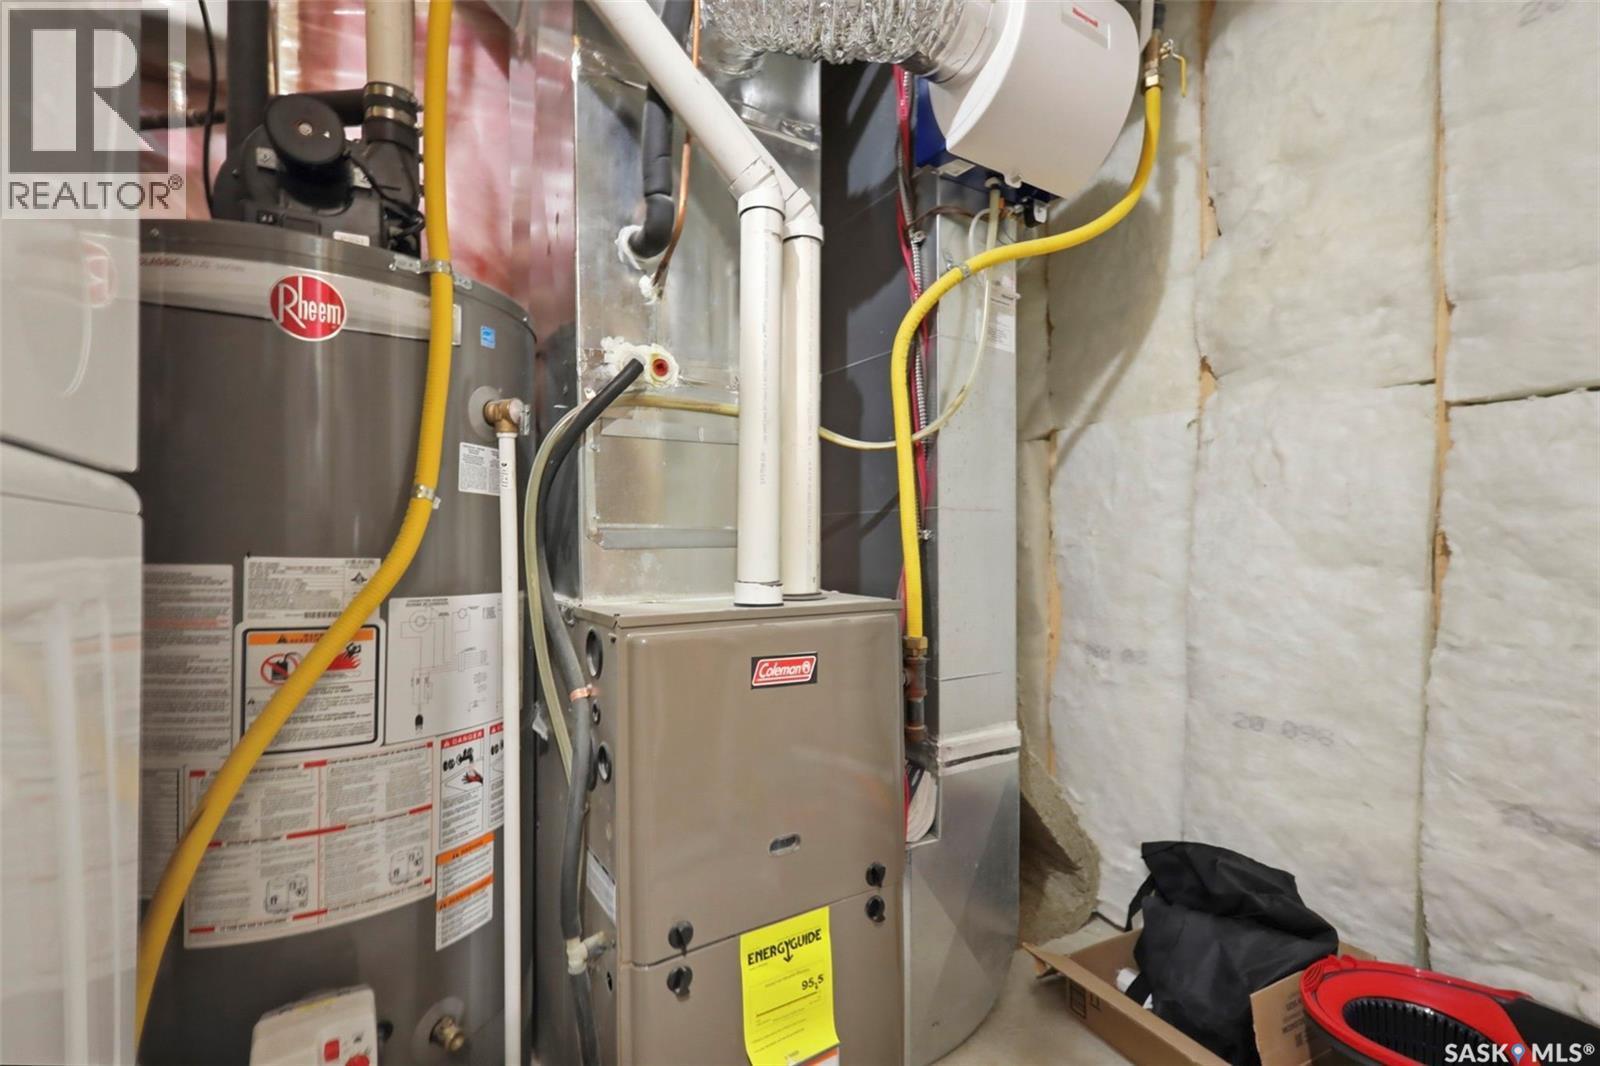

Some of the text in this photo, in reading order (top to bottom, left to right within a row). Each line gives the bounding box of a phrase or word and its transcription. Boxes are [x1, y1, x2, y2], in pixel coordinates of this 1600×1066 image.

[278, 276, 342, 328] Rheem
[758, 663, 802, 679] Coleman
[451, 730, 483, 745] DANGER
